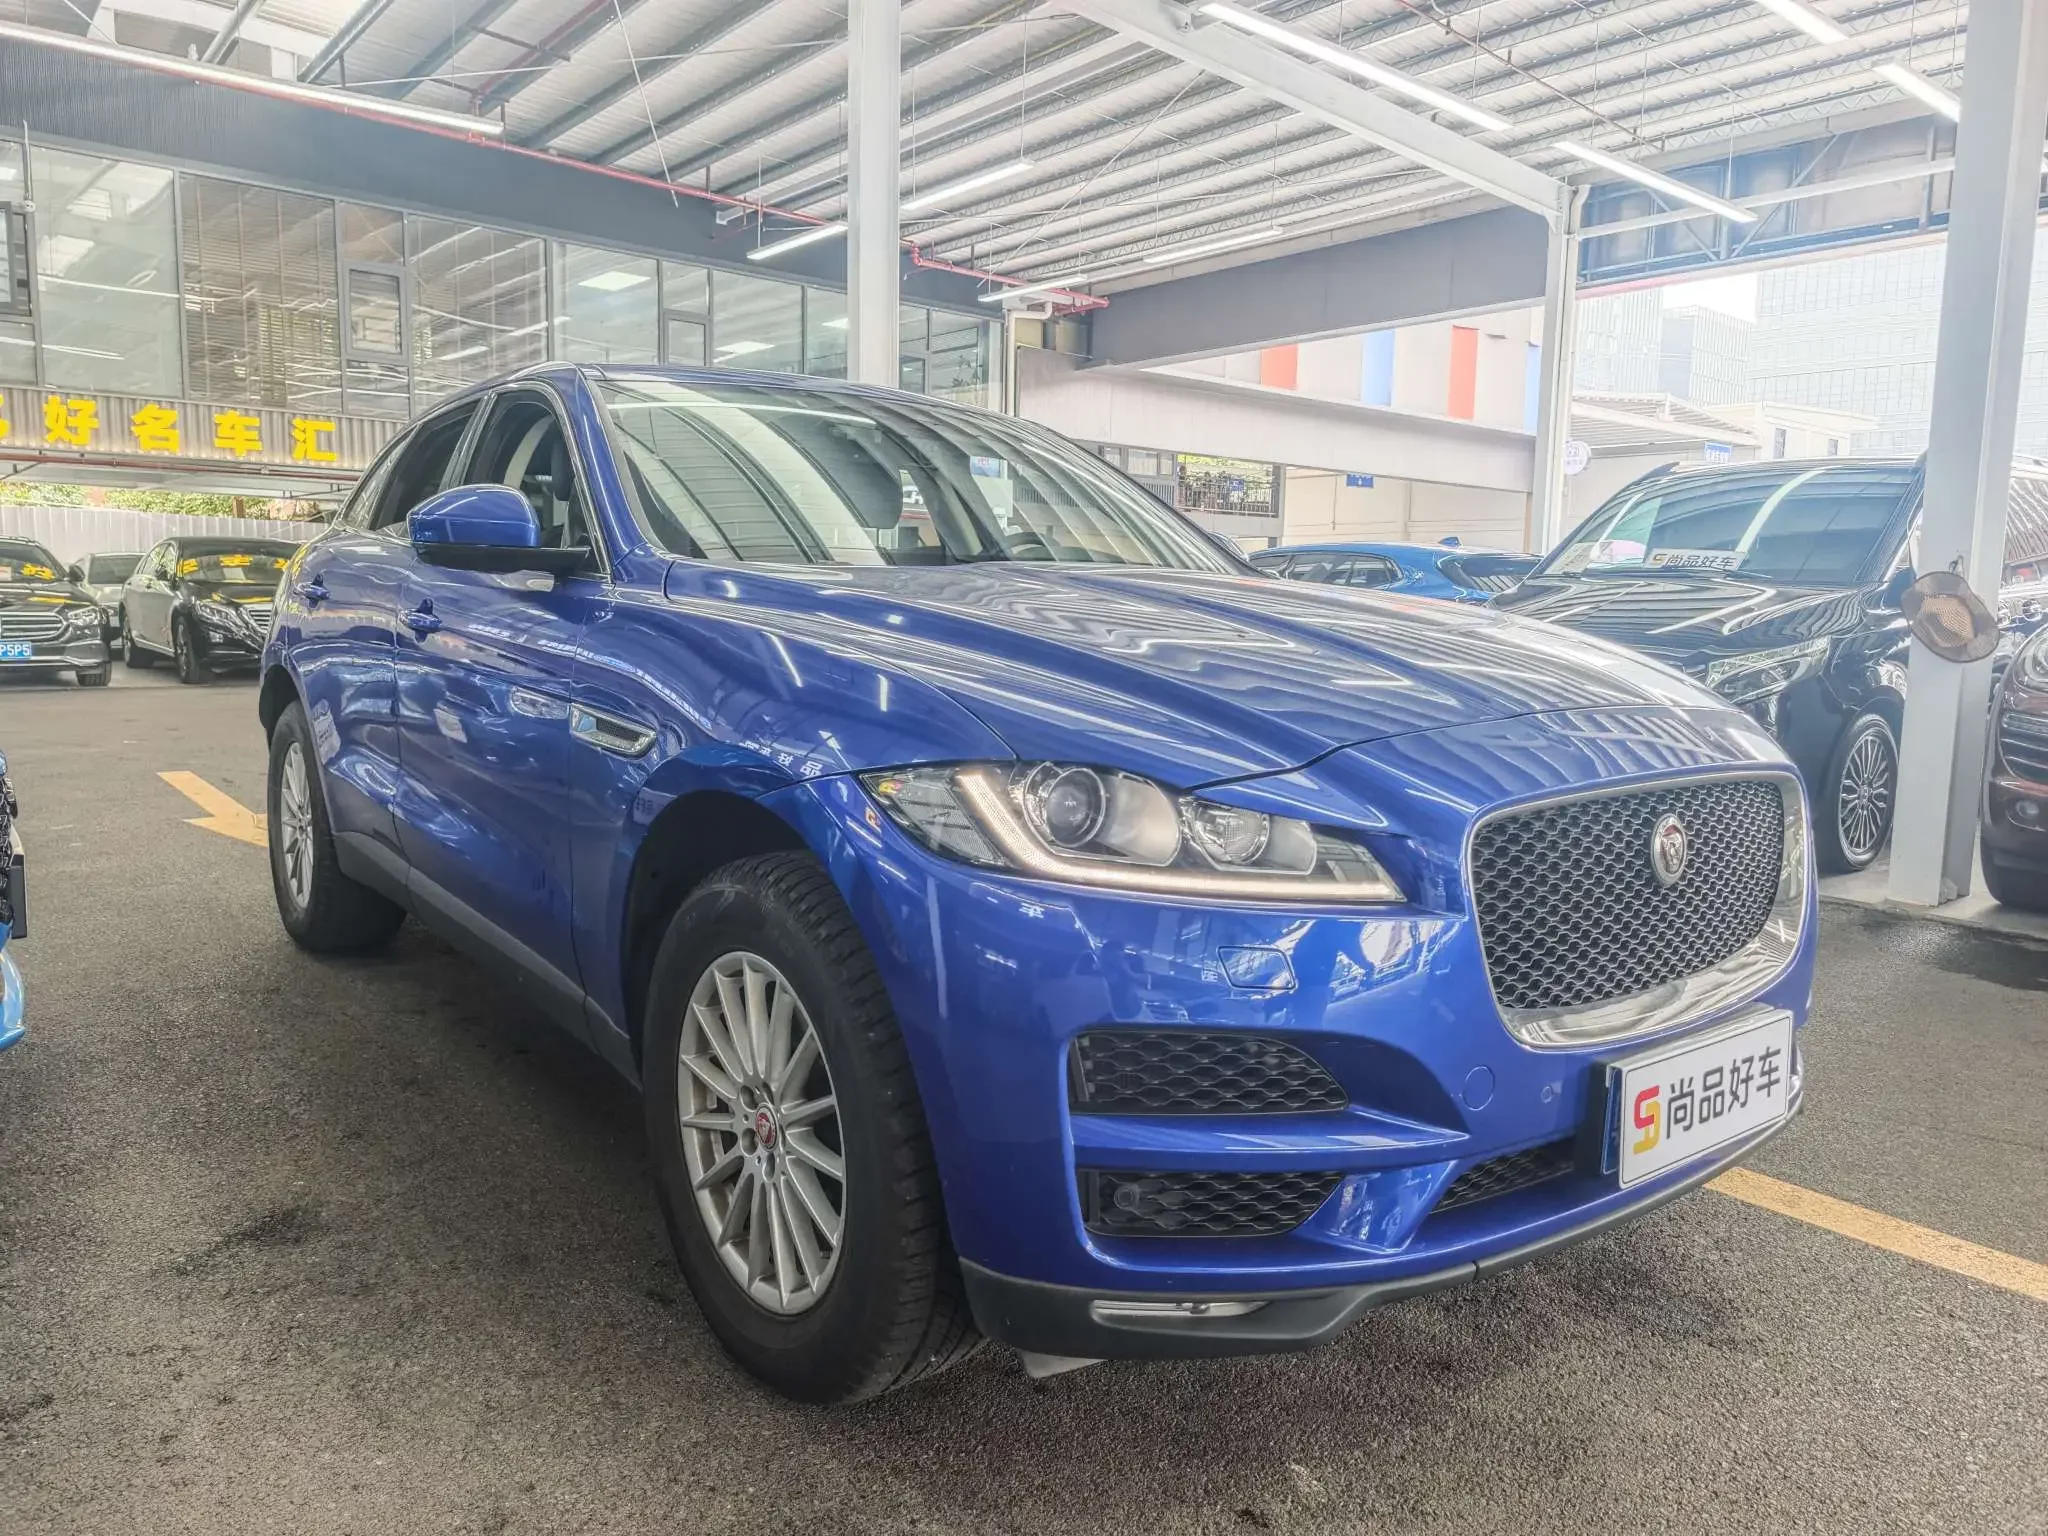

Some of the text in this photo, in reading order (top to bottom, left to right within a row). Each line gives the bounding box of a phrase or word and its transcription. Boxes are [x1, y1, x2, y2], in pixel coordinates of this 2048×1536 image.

[0, 393, 337, 462] 好名车汇
[1665, 554, 1736, 568] 尚品好车
[1666, 1046, 1782, 1140] 尚品好车
